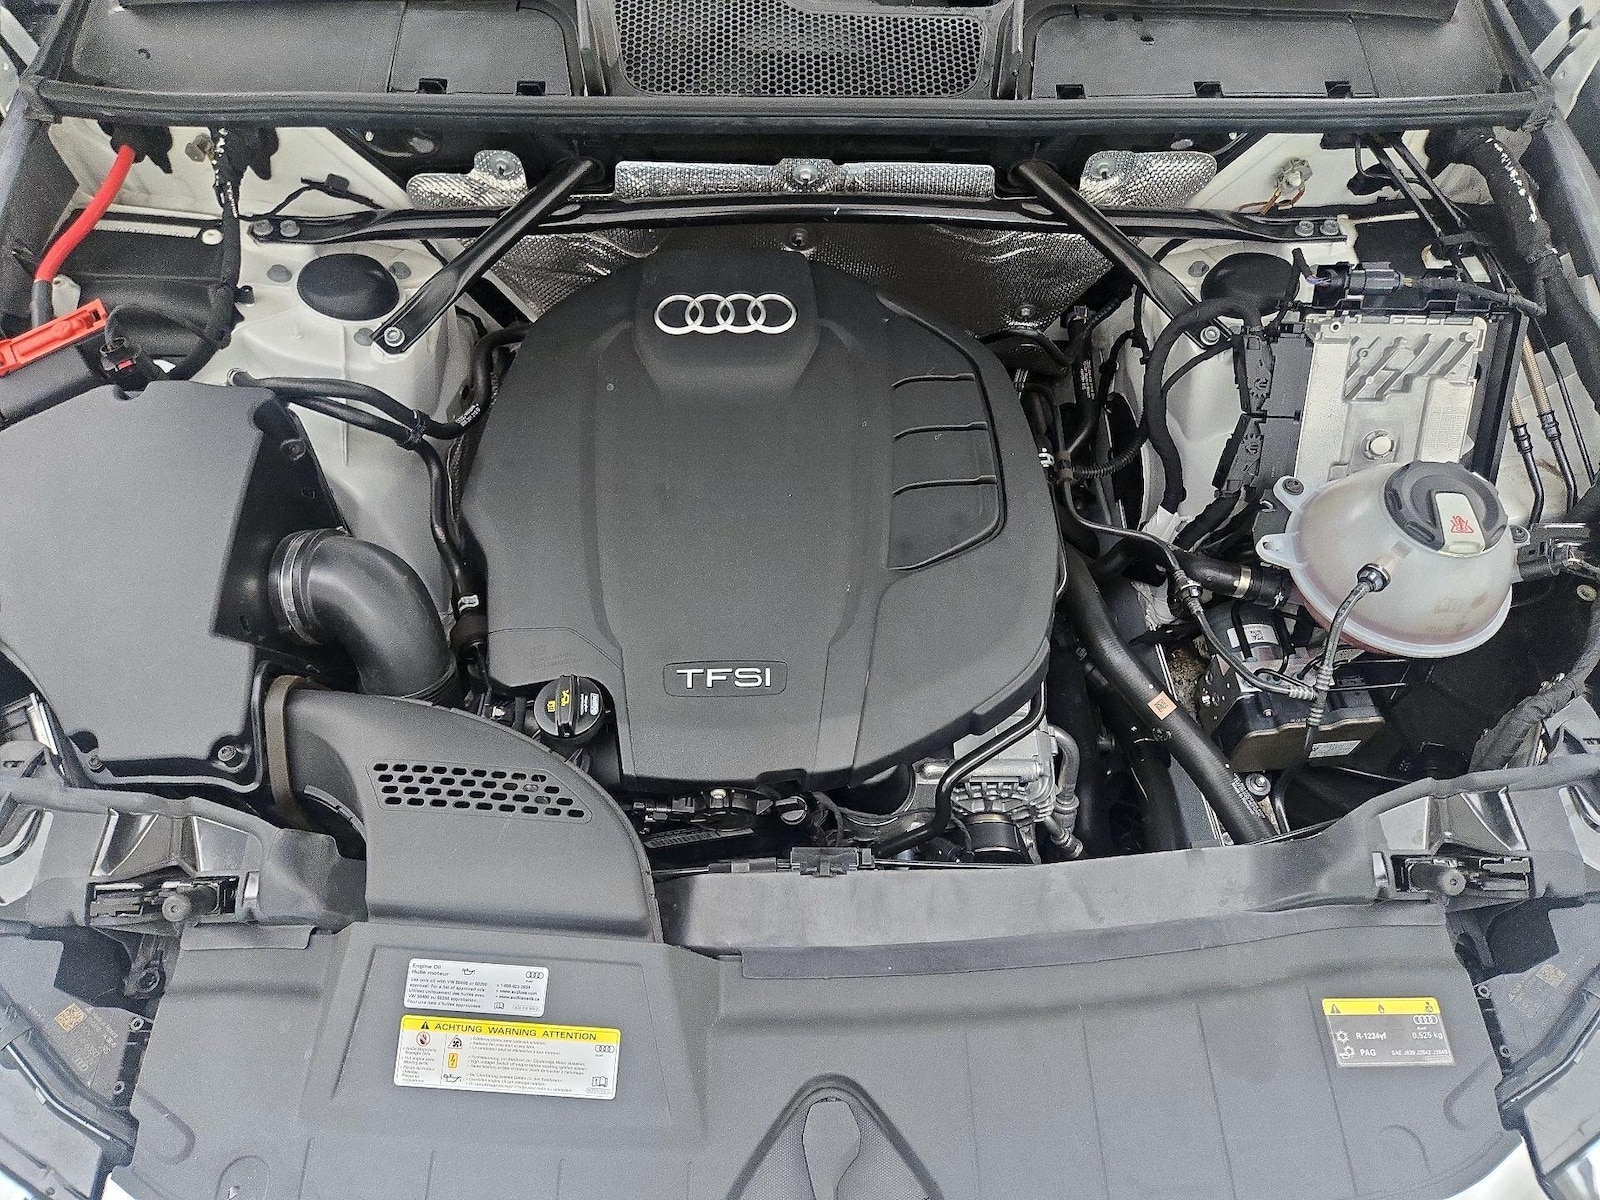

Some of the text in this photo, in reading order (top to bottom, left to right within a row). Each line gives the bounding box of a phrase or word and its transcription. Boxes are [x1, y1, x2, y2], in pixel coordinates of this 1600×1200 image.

[676, 667, 771, 689] TFSI
[434, 1024, 597, 1041] ACHTUNG WARNING ATTENTION
[1355, 1032, 1386, 1040] R-1234yf
[1433, 1032, 1443, 1040] kg
